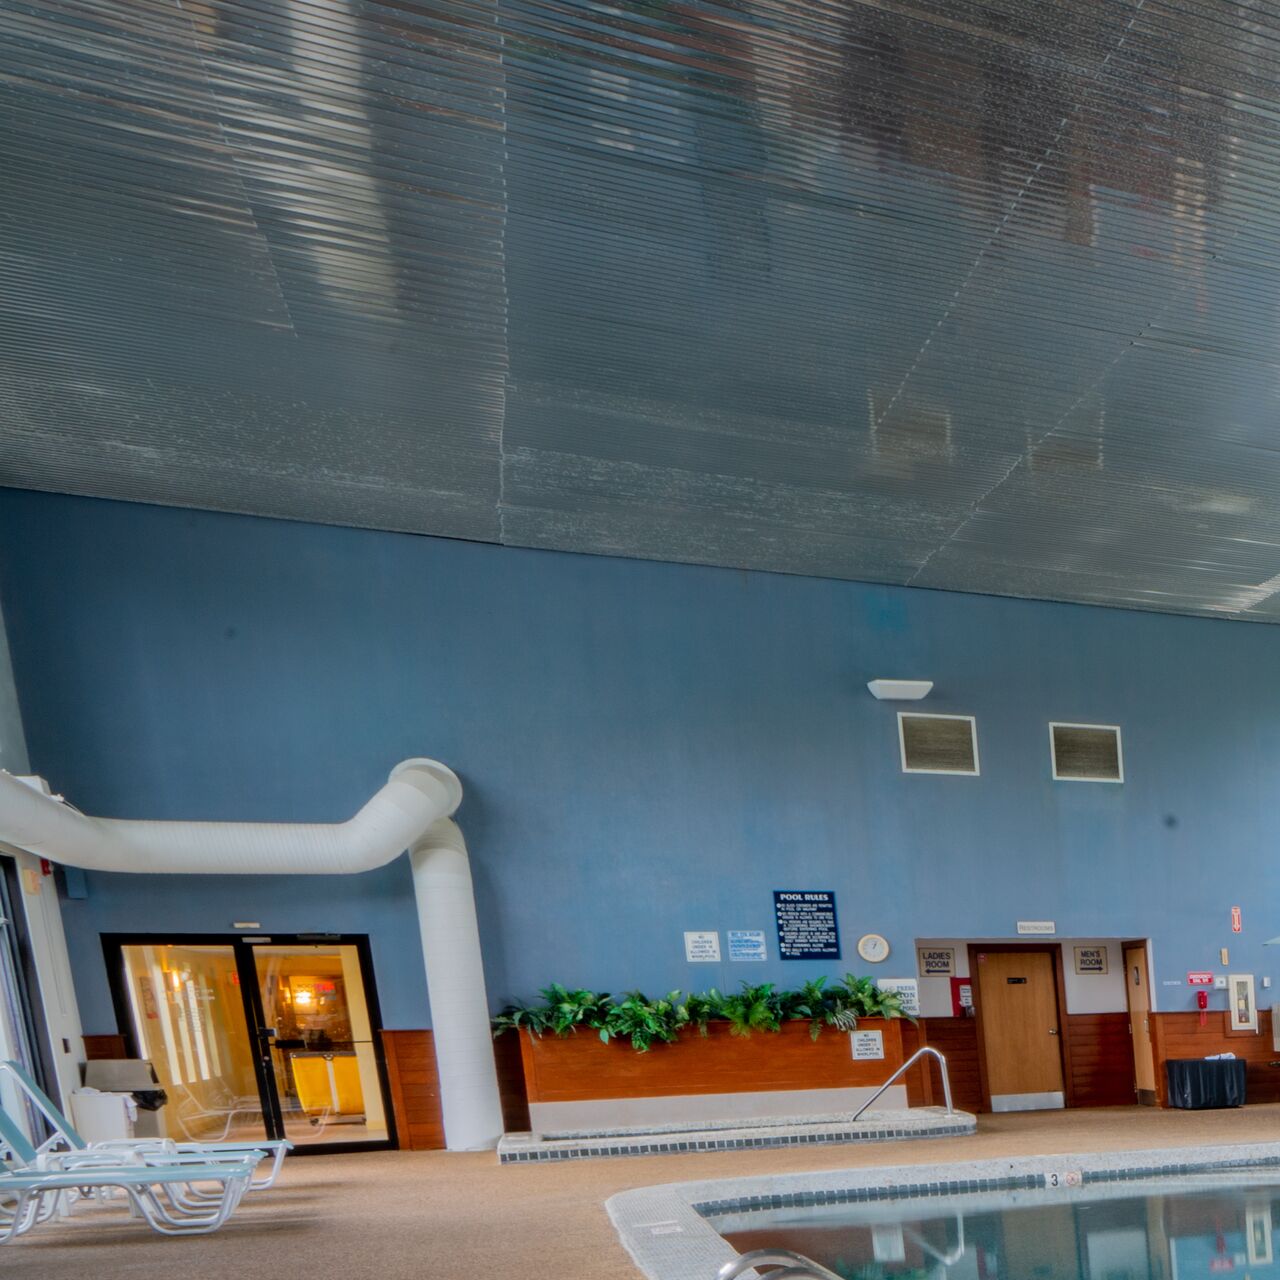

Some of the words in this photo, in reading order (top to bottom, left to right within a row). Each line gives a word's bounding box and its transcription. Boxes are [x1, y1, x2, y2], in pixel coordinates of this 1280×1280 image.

[922, 952, 951, 960] LADIES
[1080, 950, 1101, 958] MEN'S
[925, 960, 950, 968] ROOM
[1051, 1173, 1059, 1187] 3
